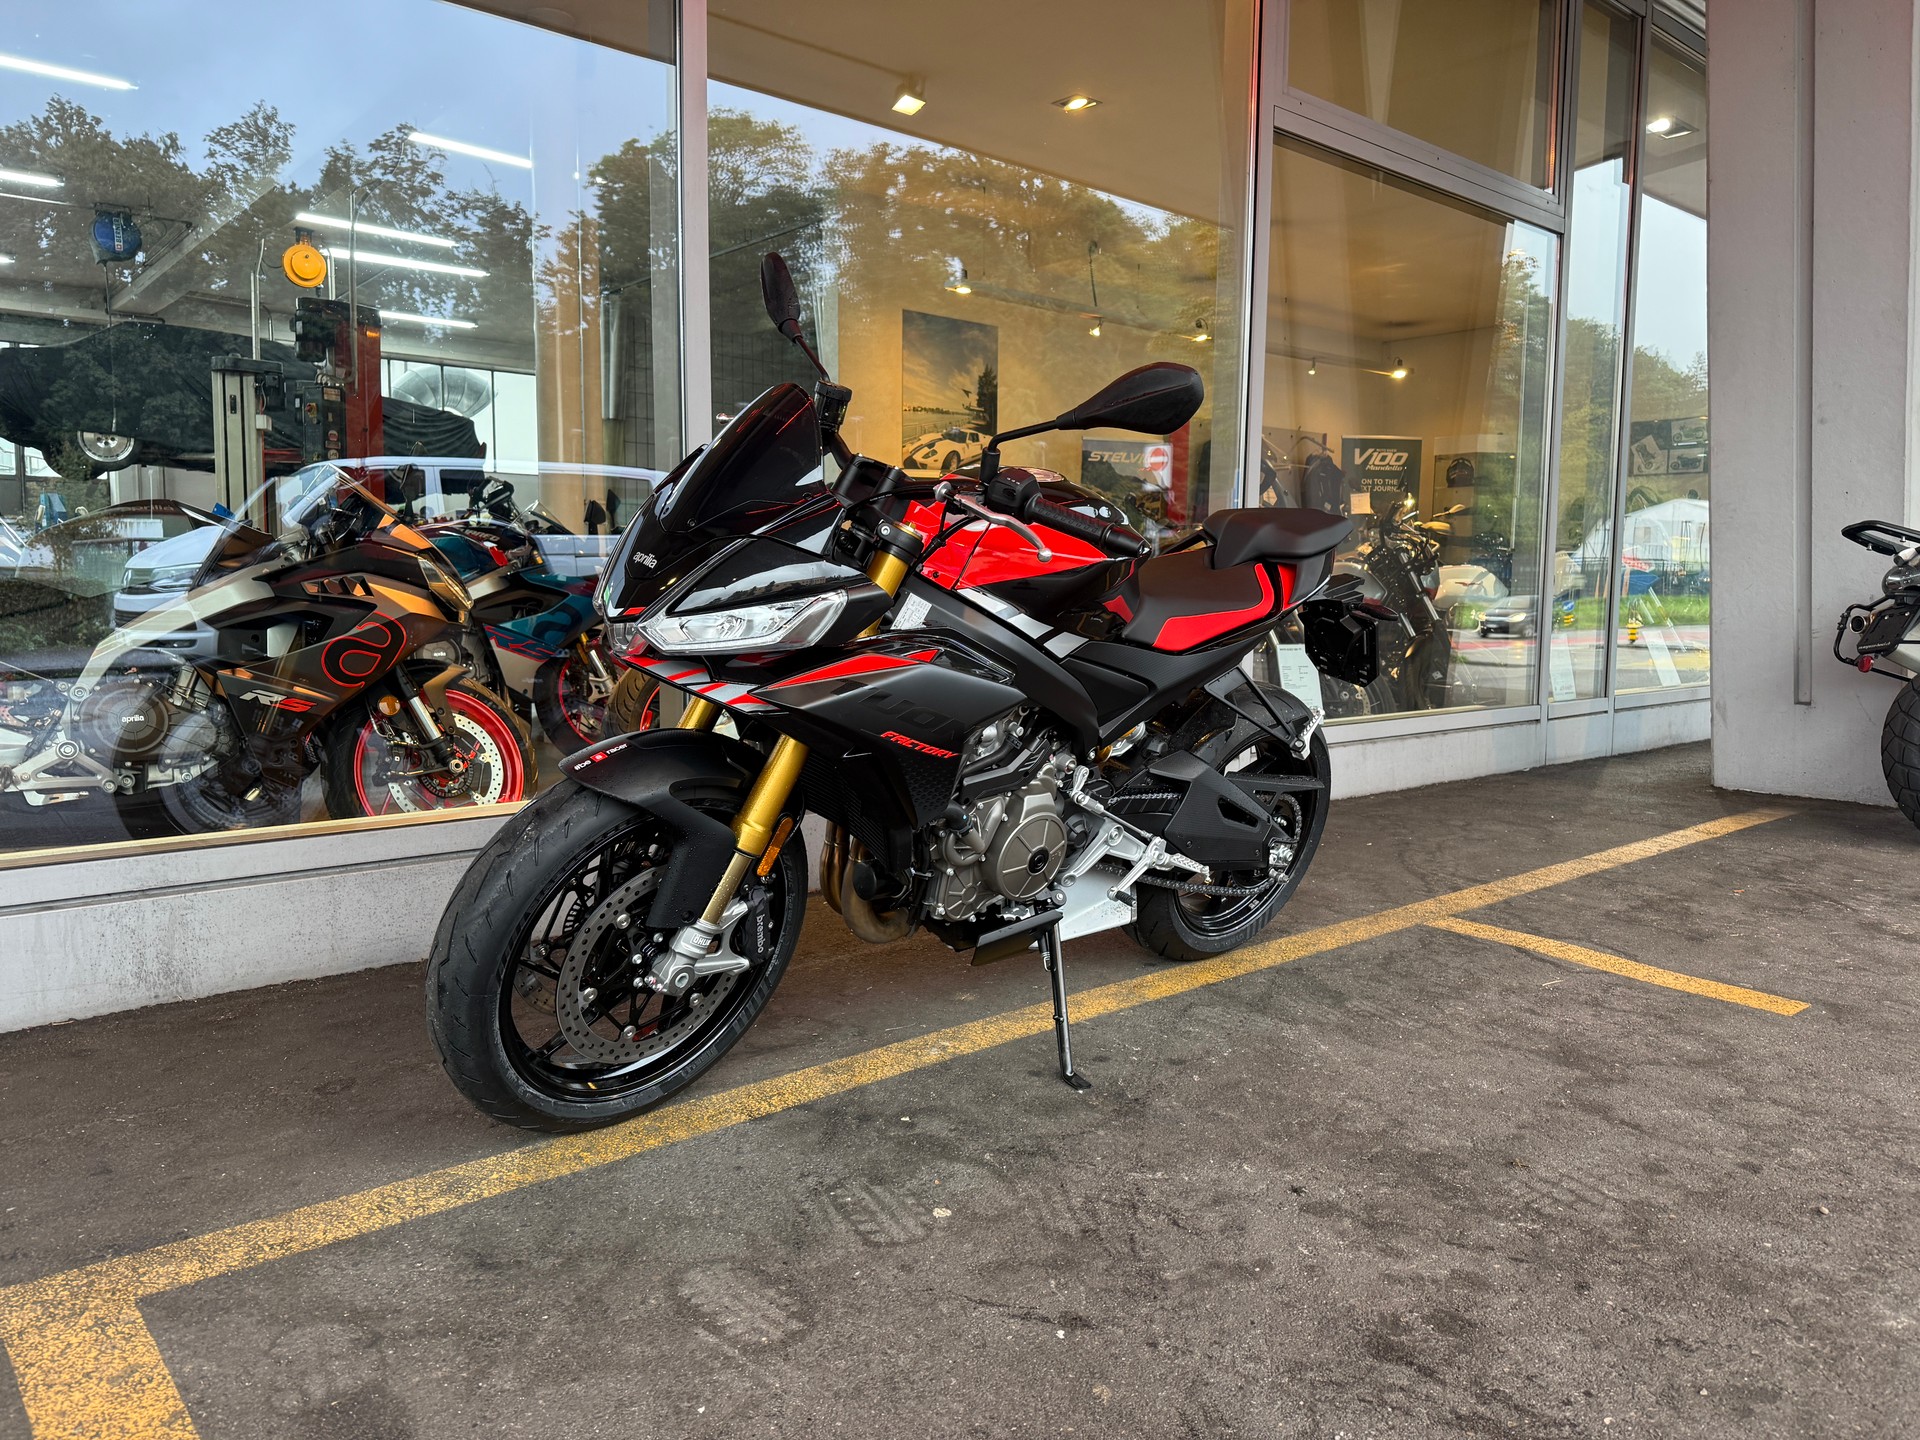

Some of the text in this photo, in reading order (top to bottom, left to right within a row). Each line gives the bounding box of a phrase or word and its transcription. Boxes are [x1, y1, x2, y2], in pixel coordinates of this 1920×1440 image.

[1354, 448, 1409, 465] V100
[633, 551, 657, 569] aprilia
[121, 714, 145, 723] aprilia
[880, 731, 960, 759] FACTORY
[756, 914, 766, 953] brembo
